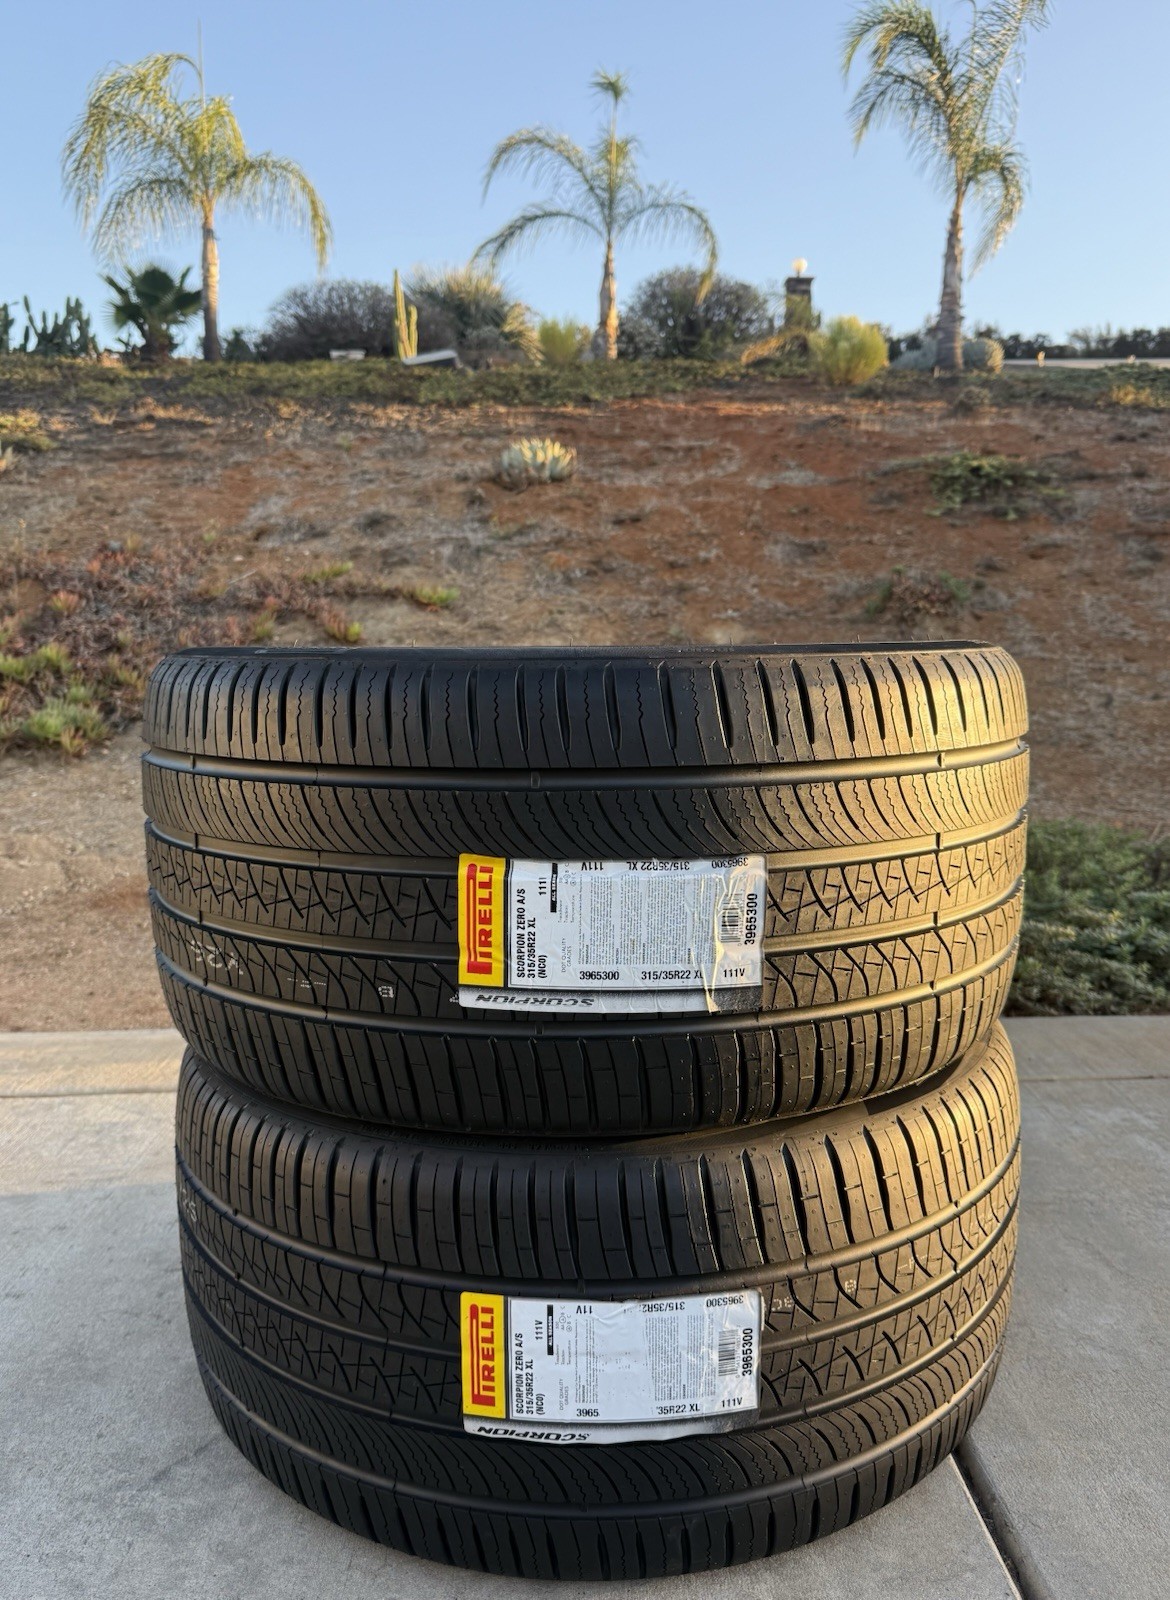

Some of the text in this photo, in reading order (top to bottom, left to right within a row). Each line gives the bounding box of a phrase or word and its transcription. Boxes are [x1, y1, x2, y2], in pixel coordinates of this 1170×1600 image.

[626, 861, 638, 871] XL
[711, 857, 749, 869] 3965300
[466, 862, 494, 975] PIRELLI
[744, 894, 758, 945] 3965300
[516, 888, 525, 978] SCORPION ZERO A/S
[527, 918, 536, 978] 315/35R22 XL
[579, 971, 619, 980] 3965300
[641, 969, 691, 980] 315/35R22
[723, 967, 746, 977] 111V
[475, 994, 594, 1007] SCORPION
[706, 1295, 744, 1308] 3965300
[535, 1320, 543, 1340] 111V
[470, 1304, 496, 1407] PIRELLI
[742, 1328, 753, 1376] 3965300
[515, 1333, 524, 1414] SCORPION ZERO A/S
[525, 1359, 534, 1414] 315/35R22 XL
[689, 1403, 700, 1412] XL
[721, 1397, 742, 1408] 111V
[478, 1426, 590, 1441] SCORPION
